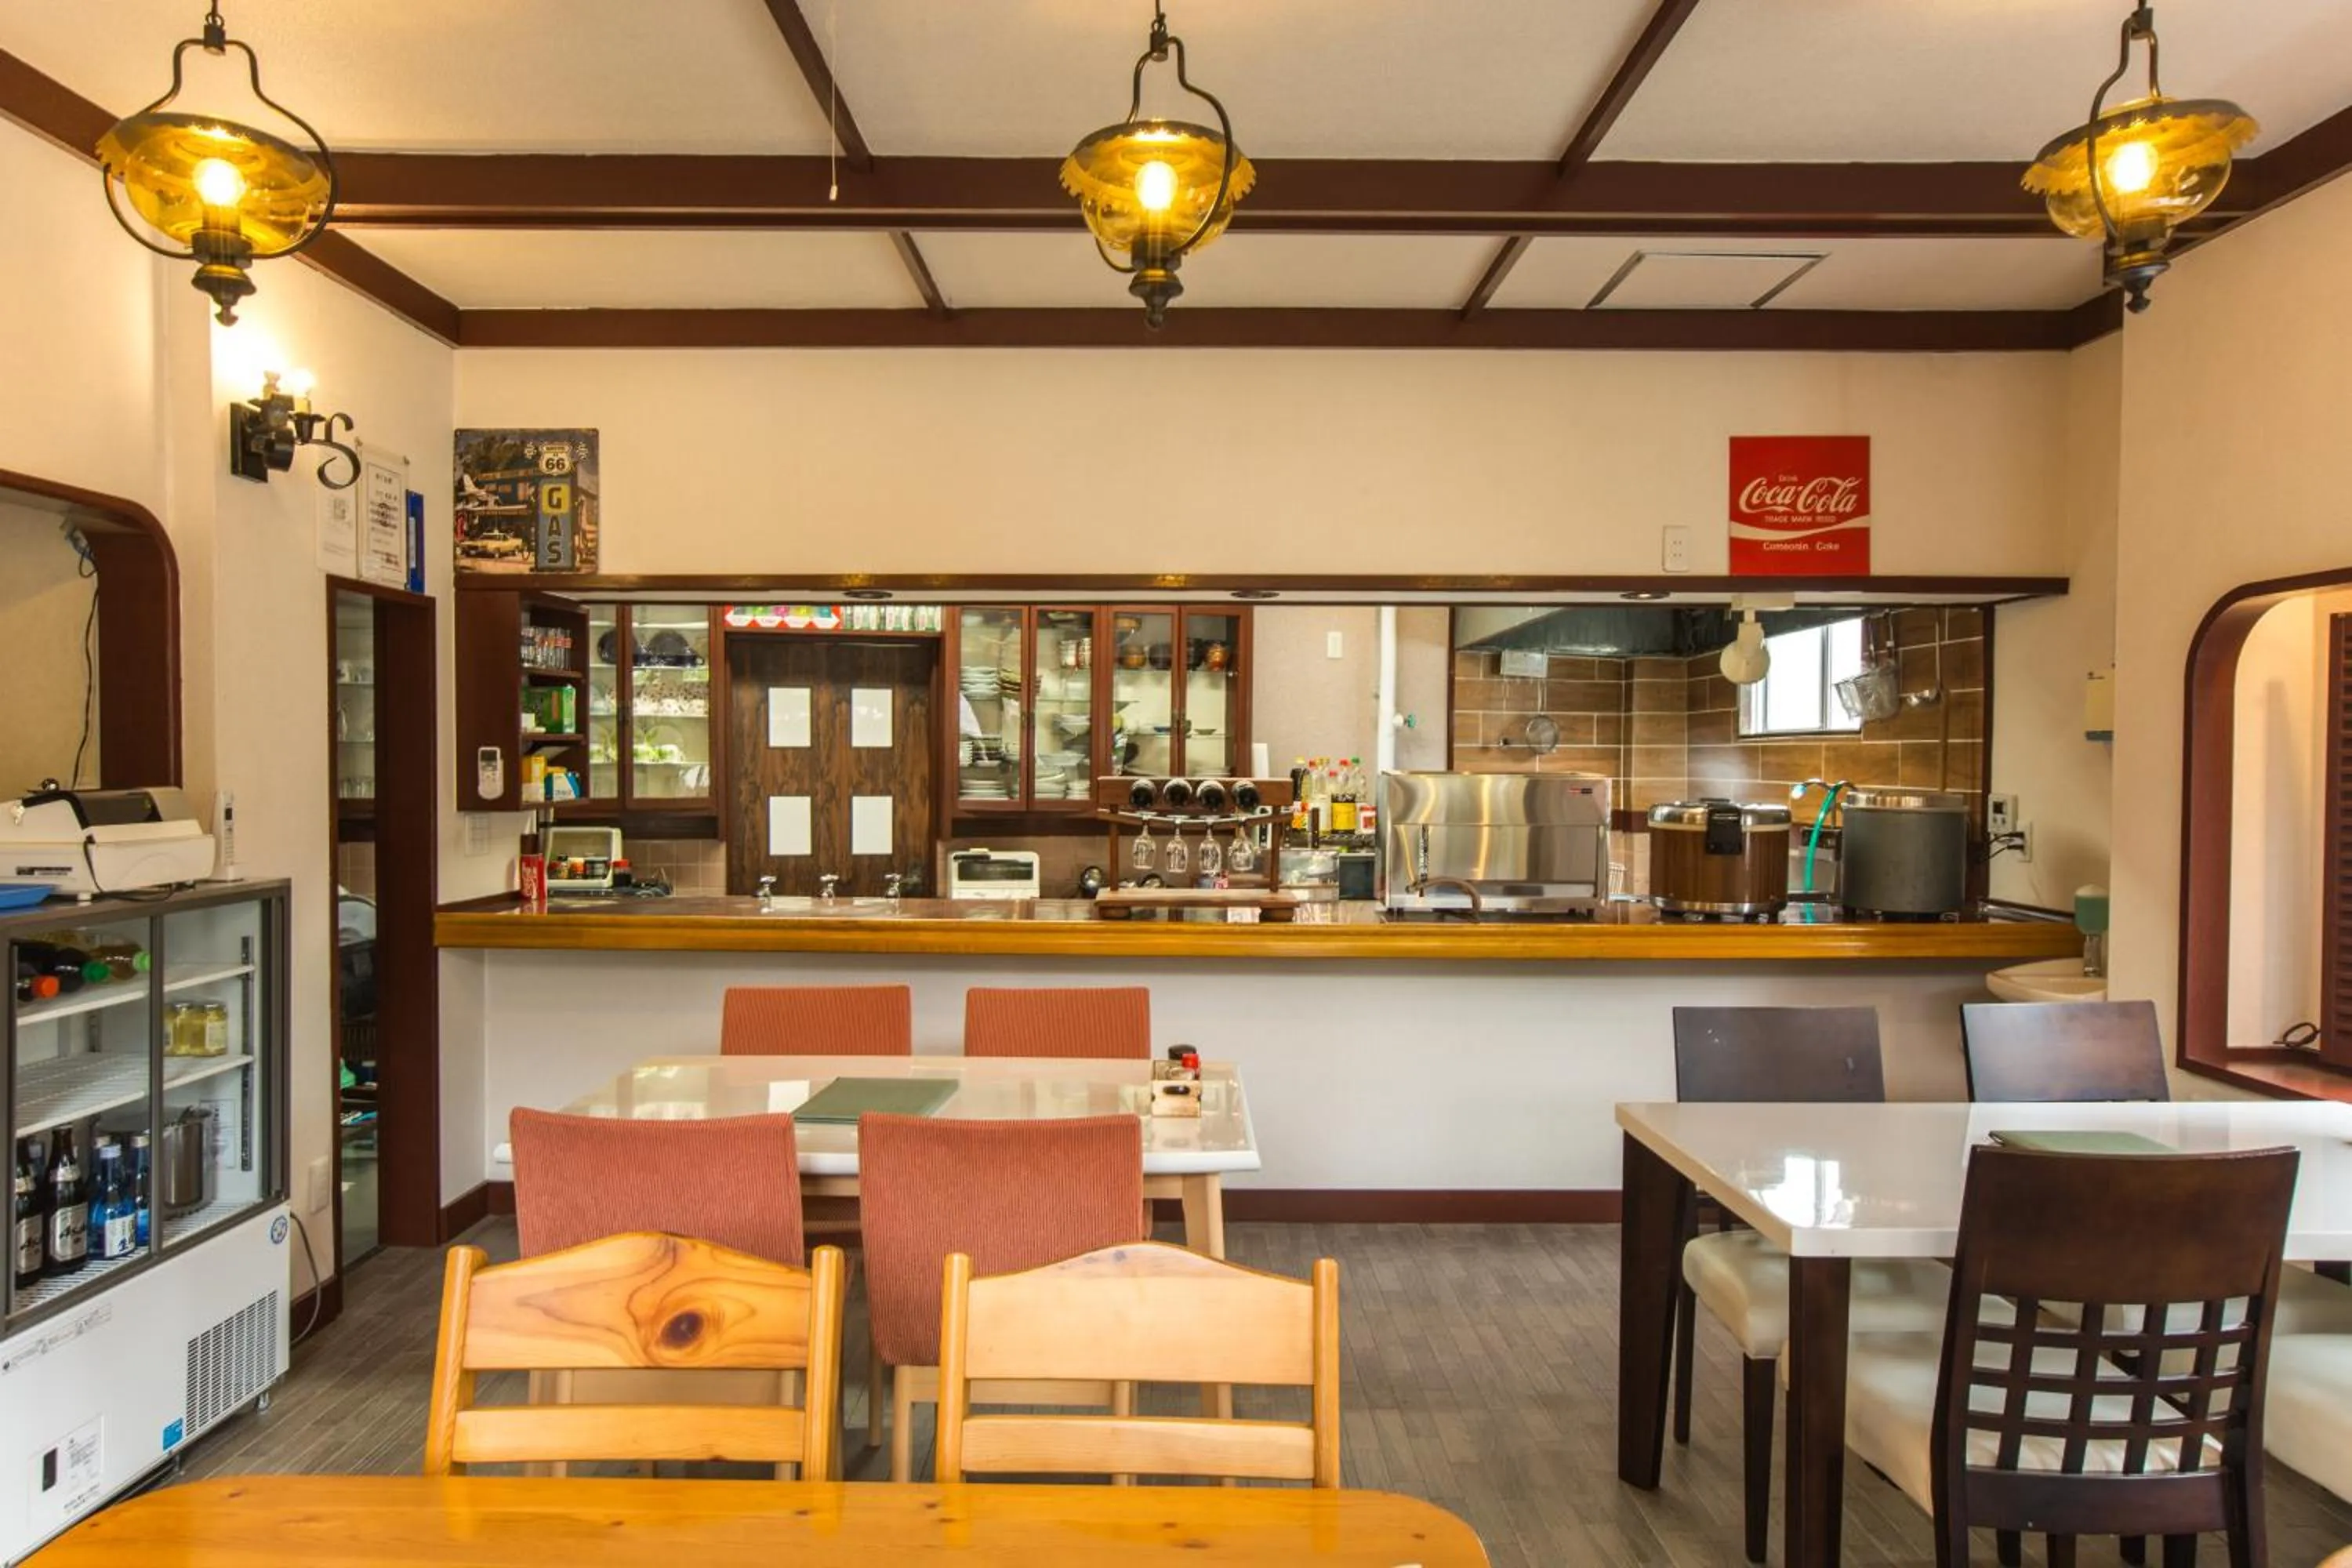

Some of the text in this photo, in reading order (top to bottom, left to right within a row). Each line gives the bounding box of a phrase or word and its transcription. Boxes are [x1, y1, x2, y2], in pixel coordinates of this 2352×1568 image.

[545, 457, 566, 471] 66
[1738, 477, 1863, 514] Coca-Cola
[547, 486, 563, 564] GAS
